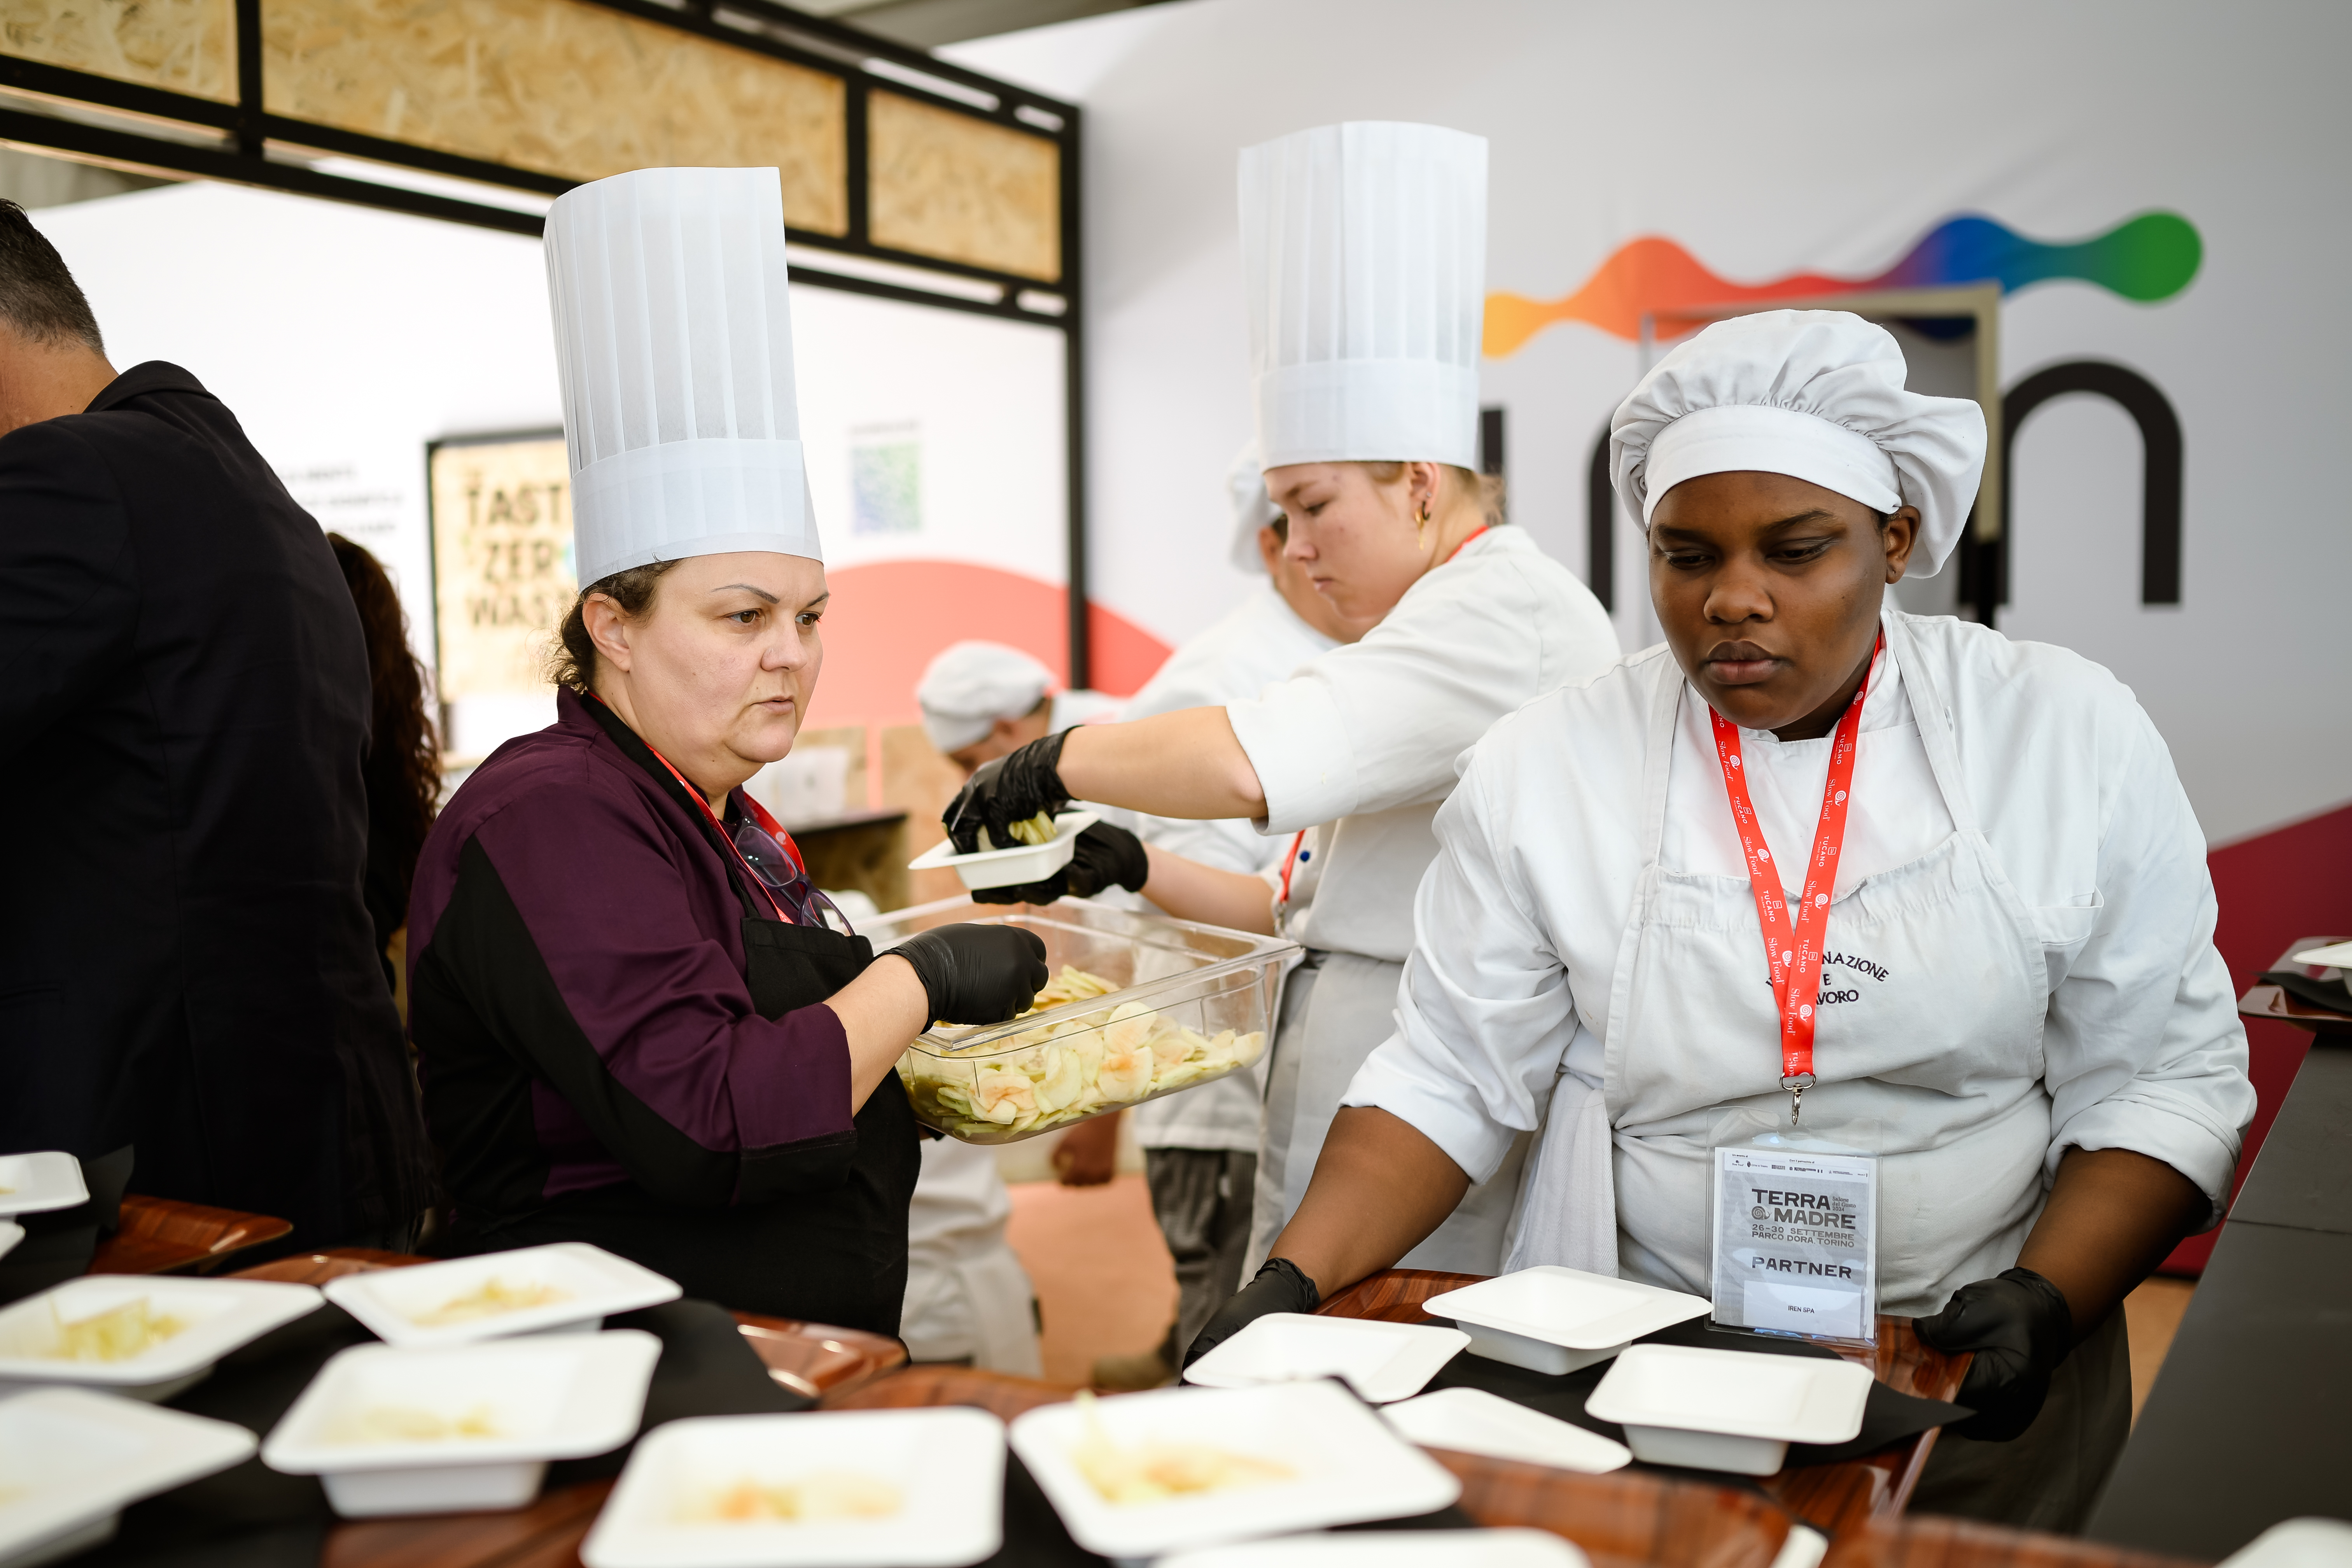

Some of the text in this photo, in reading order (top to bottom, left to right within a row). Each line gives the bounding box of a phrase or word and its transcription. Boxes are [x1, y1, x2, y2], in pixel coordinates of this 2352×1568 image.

[464, 484, 563, 526] TAST
[485, 541, 555, 581] ZER
[1718, 740, 1727, 758] Slow
[1837, 733, 1846, 765] TUCANO
[1827, 779, 1836, 798] Slow
[1735, 796, 1748, 824] TUCANO
[1743, 836, 1753, 854] Slow
[1818, 836, 1829, 867] TUCANO
[1806, 880, 1817, 898] Slow
[1763, 890, 1776, 922] TUCANO
[1768, 937, 1778, 959] Slow
[1800, 939, 1810, 973] TUCANO
[1822, 951, 1889, 982] NAZIONE
[1823, 974, 1831, 985] E
[1789, 988, 1800, 1009] Slow
[1816, 990, 1859, 1005] VORO
[1752, 1188, 1831, 1210] TERRA
[1774, 1208, 1856, 1230] MADRE
[1752, 1224, 1855, 1241] 26-30 SETTEMBRE
[1752, 1231, 1784, 1240] PARCO
[1817, 1238, 1855, 1248] TORINO
[1752, 1256, 1852, 1279] PARTNER
